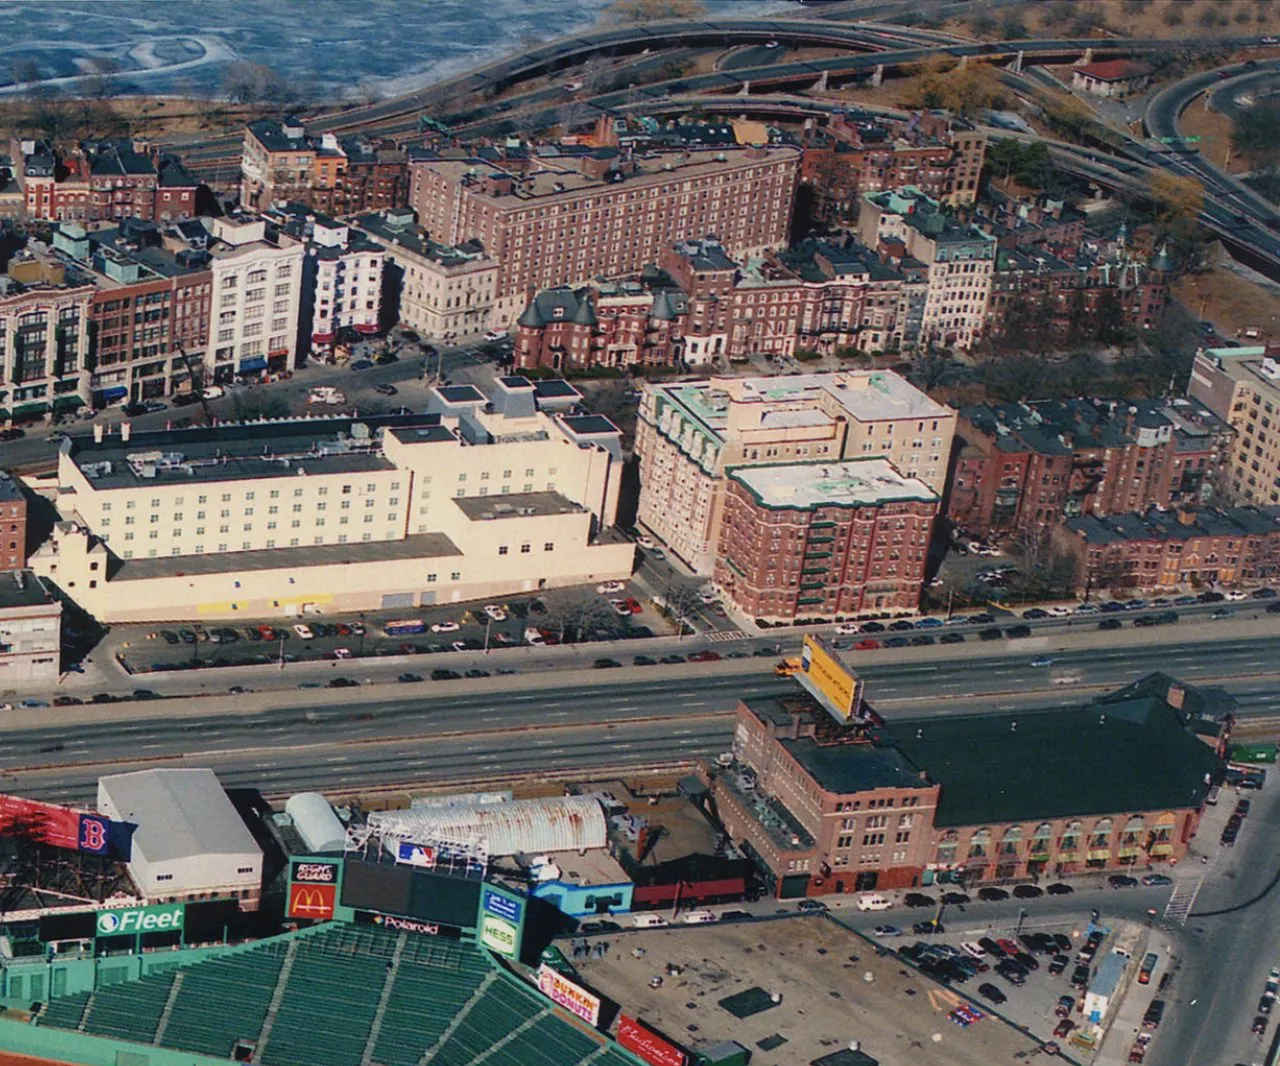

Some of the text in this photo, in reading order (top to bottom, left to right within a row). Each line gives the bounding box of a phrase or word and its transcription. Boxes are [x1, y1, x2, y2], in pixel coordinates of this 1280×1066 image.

[81, 818, 106, 850] B
[119, 909, 183, 932] Fleet
[385, 916, 439, 935] Polaroid
[485, 926, 513, 945] HESS
[552, 990, 593, 1021] DONUTS
